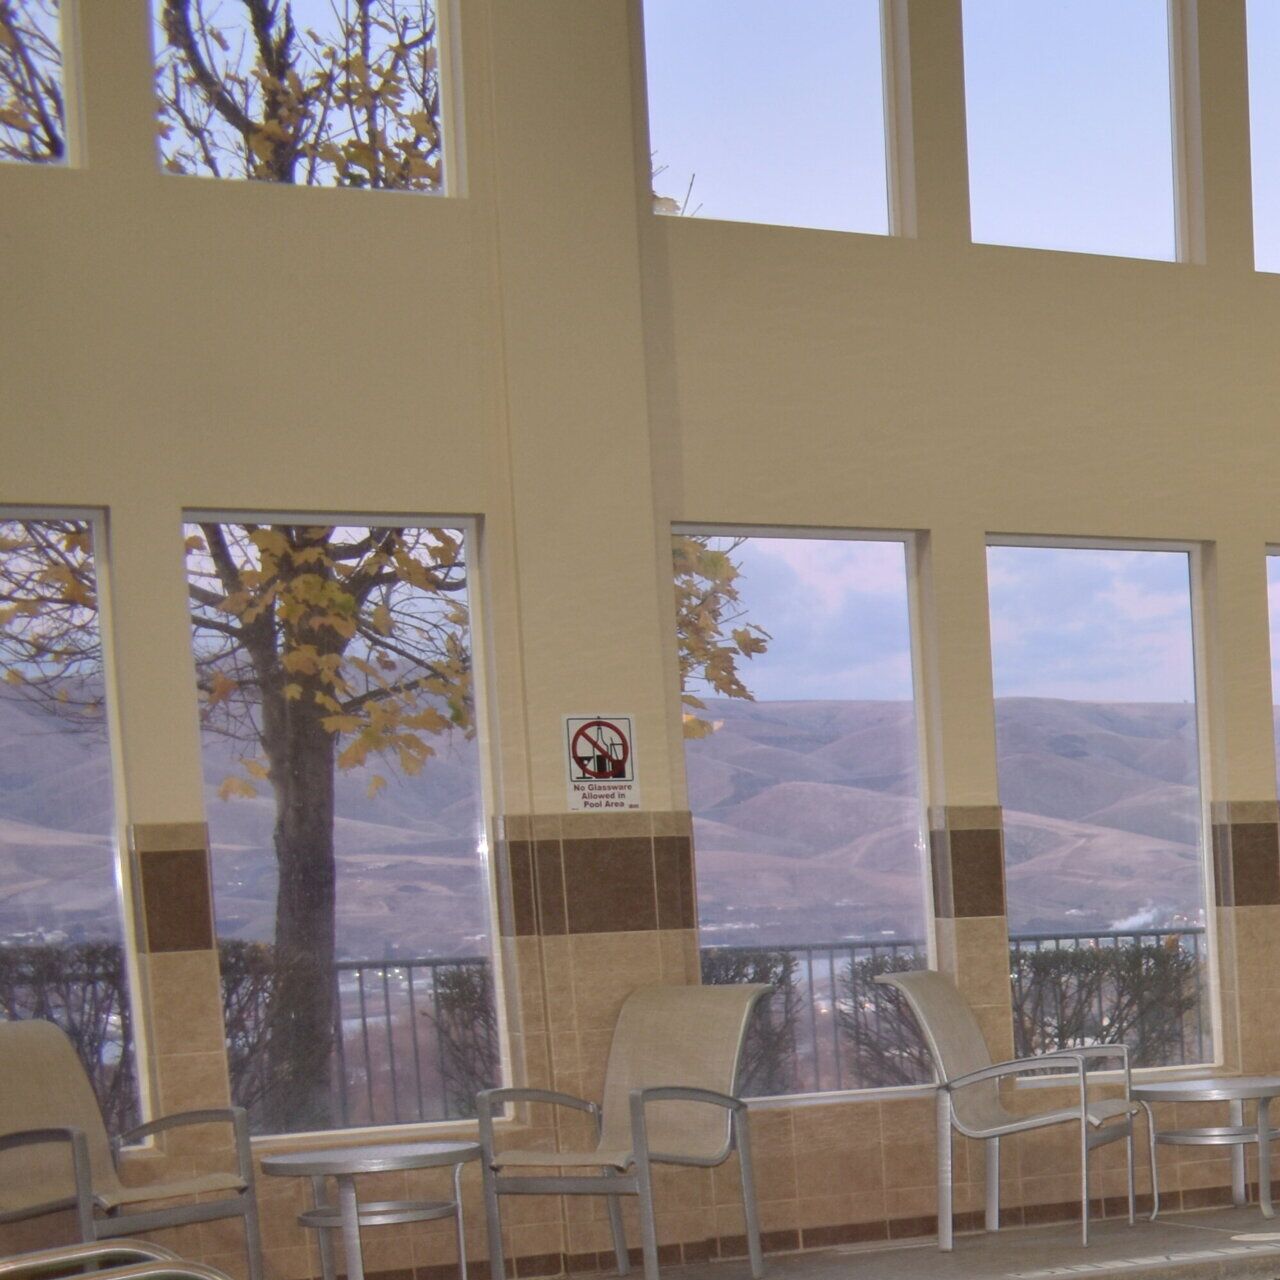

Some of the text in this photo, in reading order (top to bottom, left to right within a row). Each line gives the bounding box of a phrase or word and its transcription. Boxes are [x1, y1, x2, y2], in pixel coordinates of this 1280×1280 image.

[573, 783, 633, 792] No Glassware
[582, 792, 616, 800] Allowed
[583, 800, 603, 808] Pool
[604, 800, 625, 808] Area
